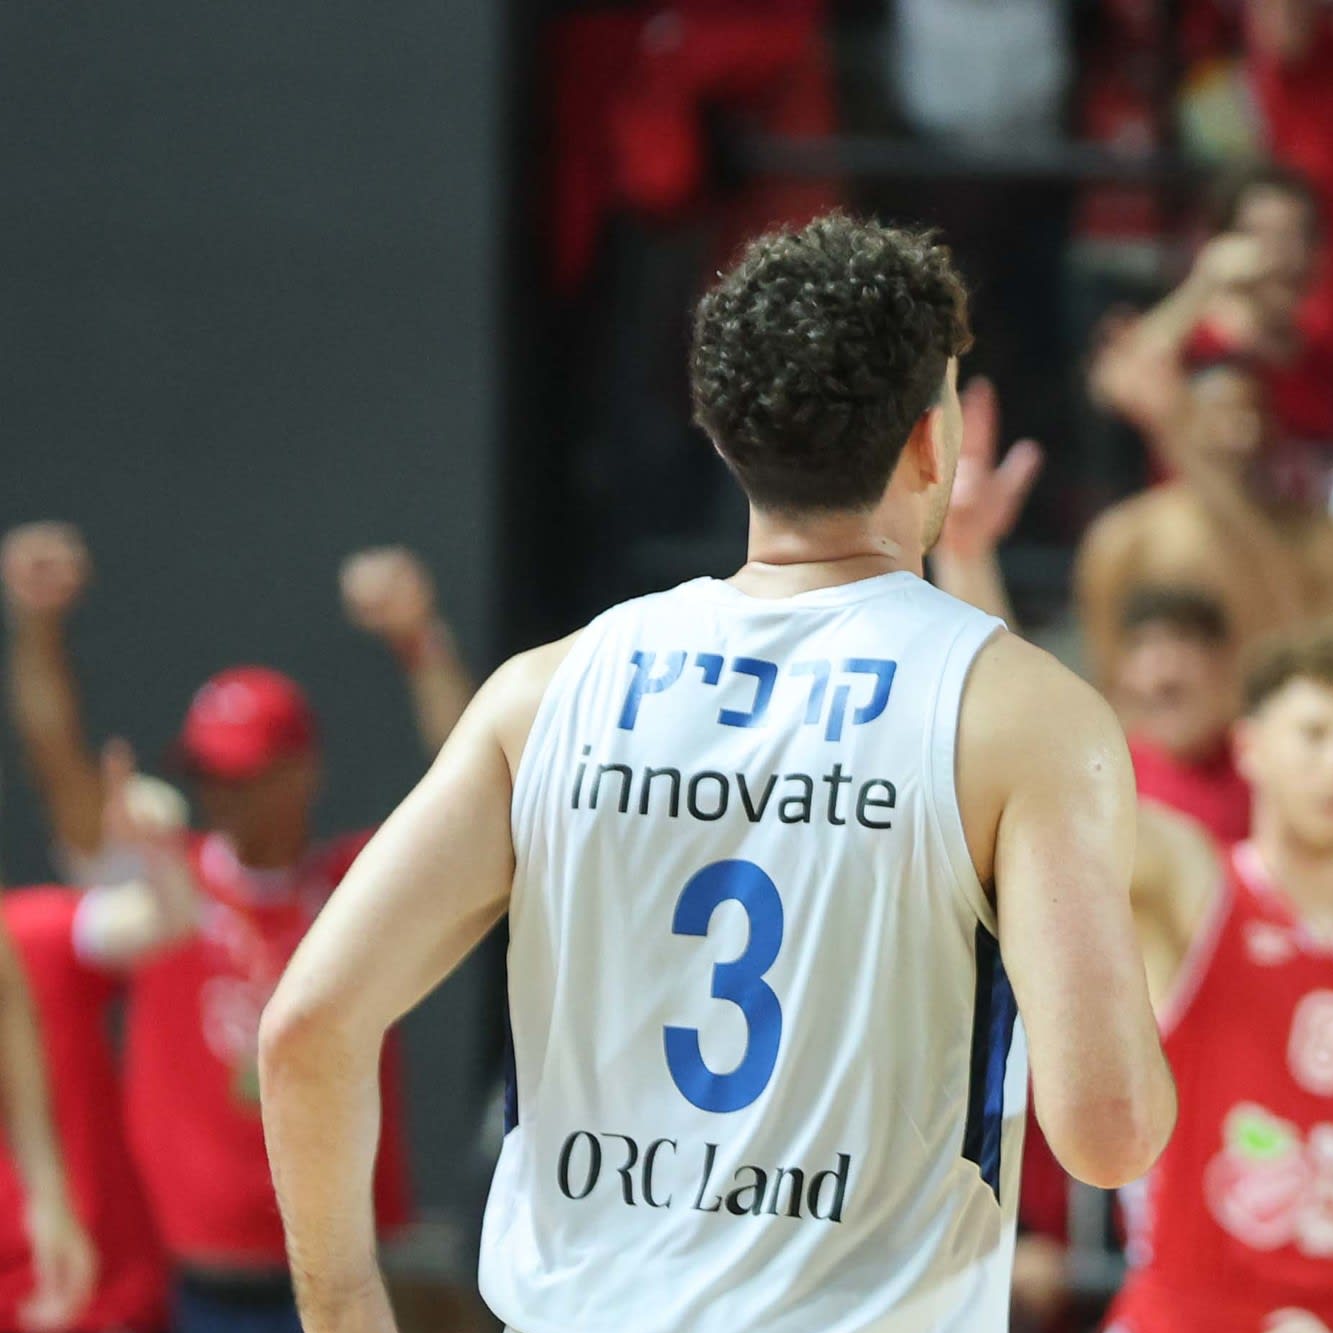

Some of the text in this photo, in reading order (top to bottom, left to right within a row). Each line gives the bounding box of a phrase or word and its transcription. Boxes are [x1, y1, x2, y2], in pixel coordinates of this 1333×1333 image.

[570, 745, 898, 830] innovate
[662, 858, 785, 1115] 3
[557, 1129, 852, 1225] ORC Land
